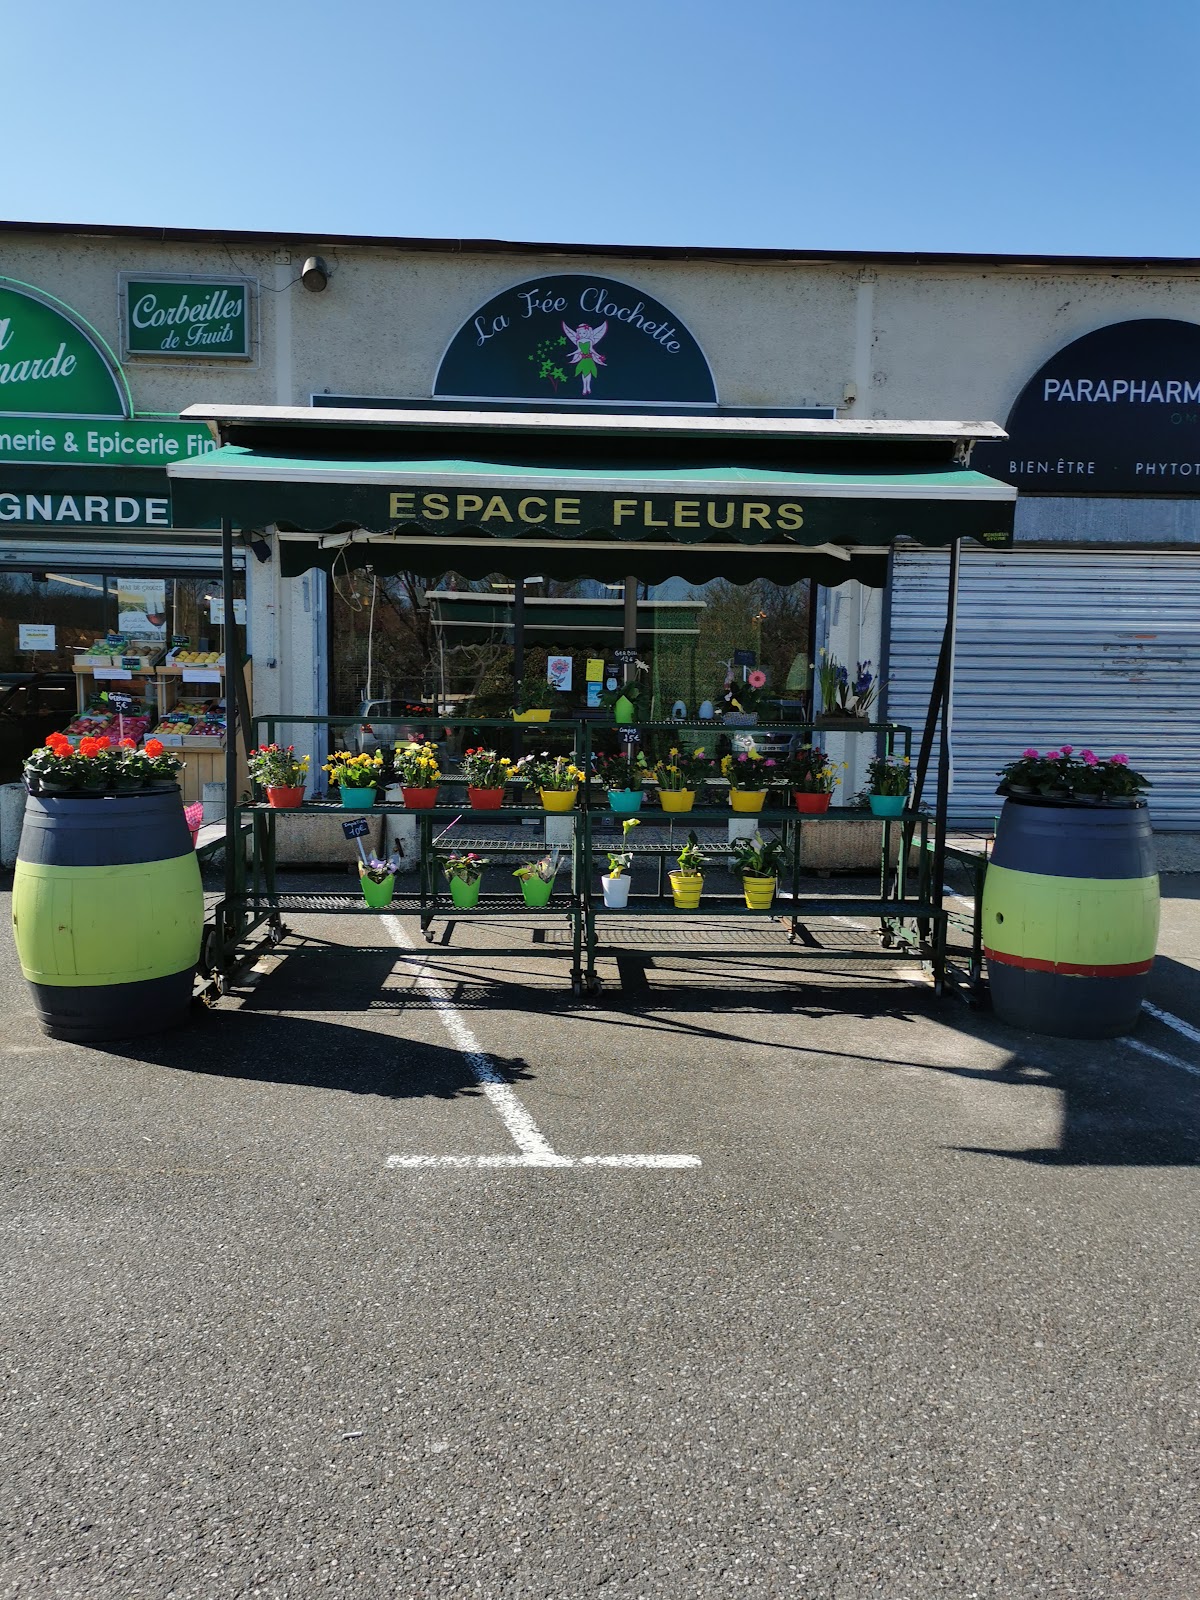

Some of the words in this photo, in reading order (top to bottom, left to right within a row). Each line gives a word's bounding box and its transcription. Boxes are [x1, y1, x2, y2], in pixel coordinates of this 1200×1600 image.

[132, 289, 243, 329] Corbeilles
[474, 311, 510, 347] La
[517, 288, 568, 319] Fée
[579, 287, 681, 354] Clochette
[161, 330, 180, 350] de
[184, 323, 233, 347] Fruits
[1044, 379, 1200, 403] PARAPHARM
[63, 431, 78, 452] &
[87, 431, 178, 457] Epicerie
[1009, 458, 1095, 474] BIEN-ÊTRE
[0, 493, 169, 525] GNARDE
[389, 492, 581, 525] ESPACE
[612, 499, 805, 531] FLEURS
[115, 701, 129, 712] 5€
